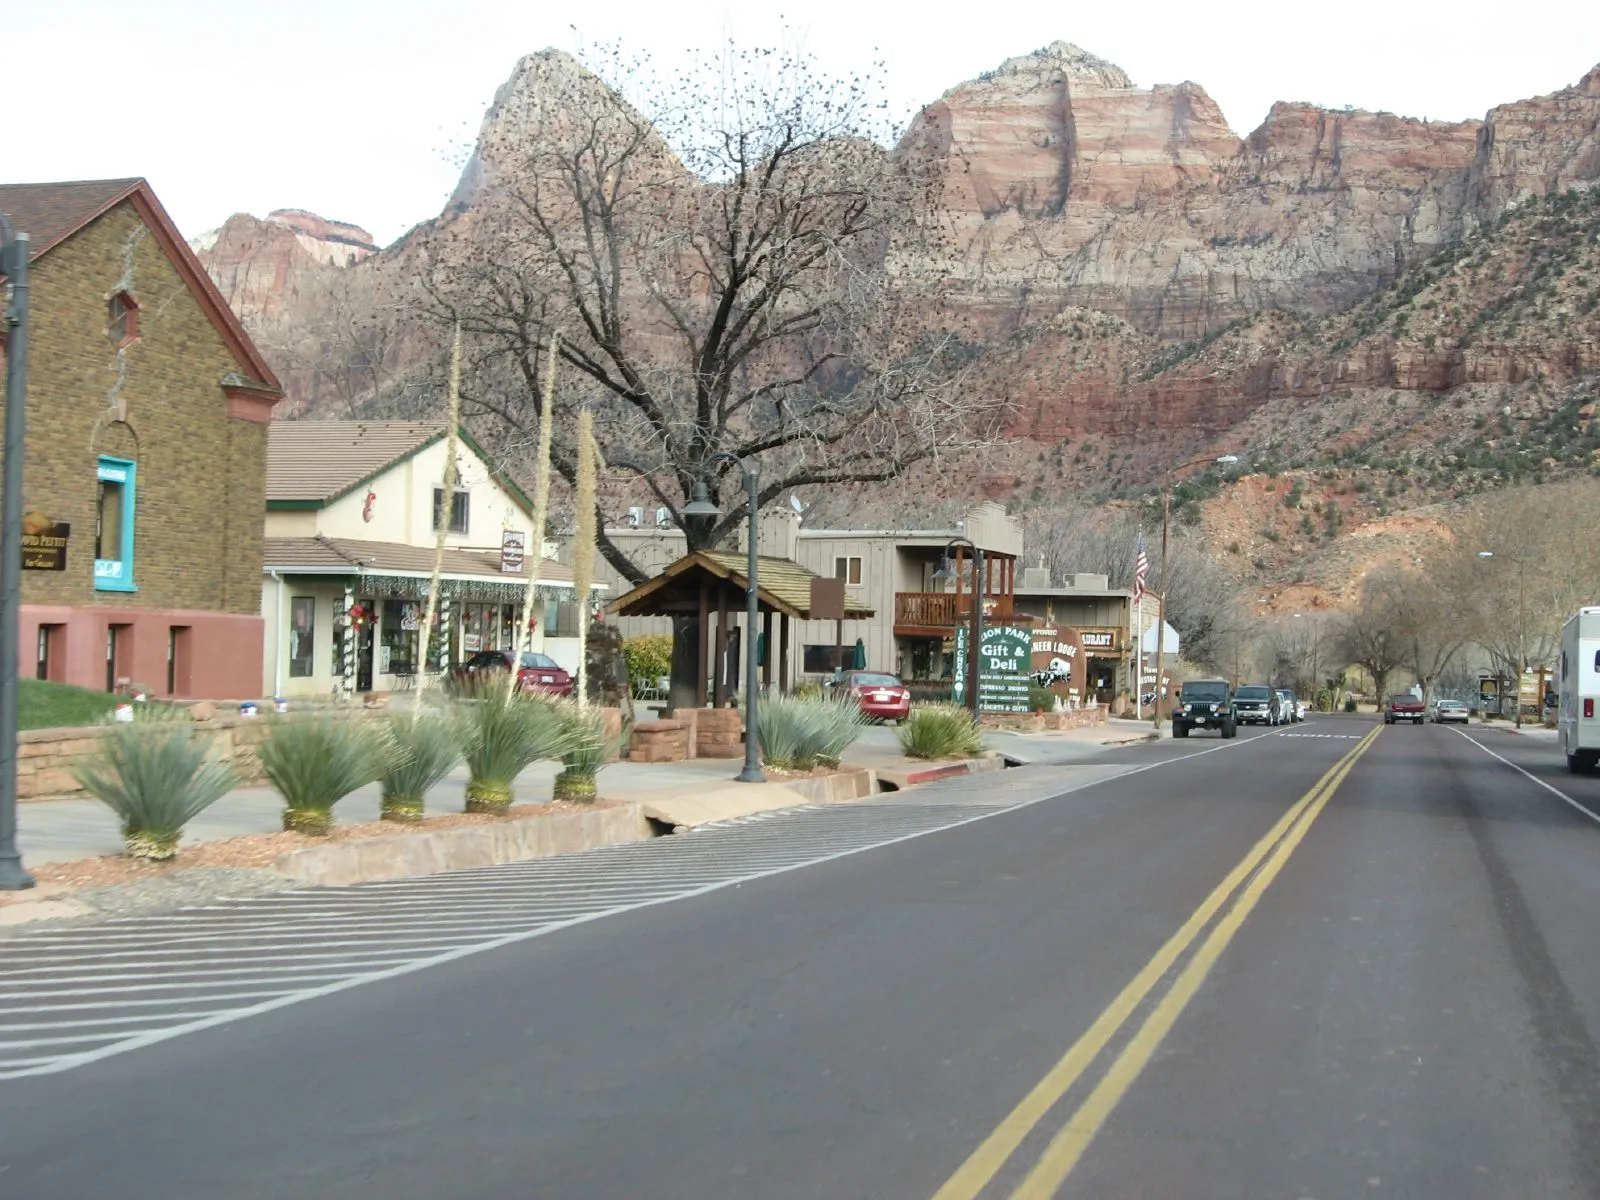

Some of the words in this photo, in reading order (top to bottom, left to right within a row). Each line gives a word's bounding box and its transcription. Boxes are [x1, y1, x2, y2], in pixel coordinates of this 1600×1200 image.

[957, 628, 965, 649] ICE
[1005, 626, 1032, 645] PARK
[981, 644, 1009, 656] Gift
[1014, 646, 1025, 657] &
[1053, 642, 1078, 658] LODGE
[955, 649, 965, 682] CREAM
[990, 657, 1017, 670] Deli
